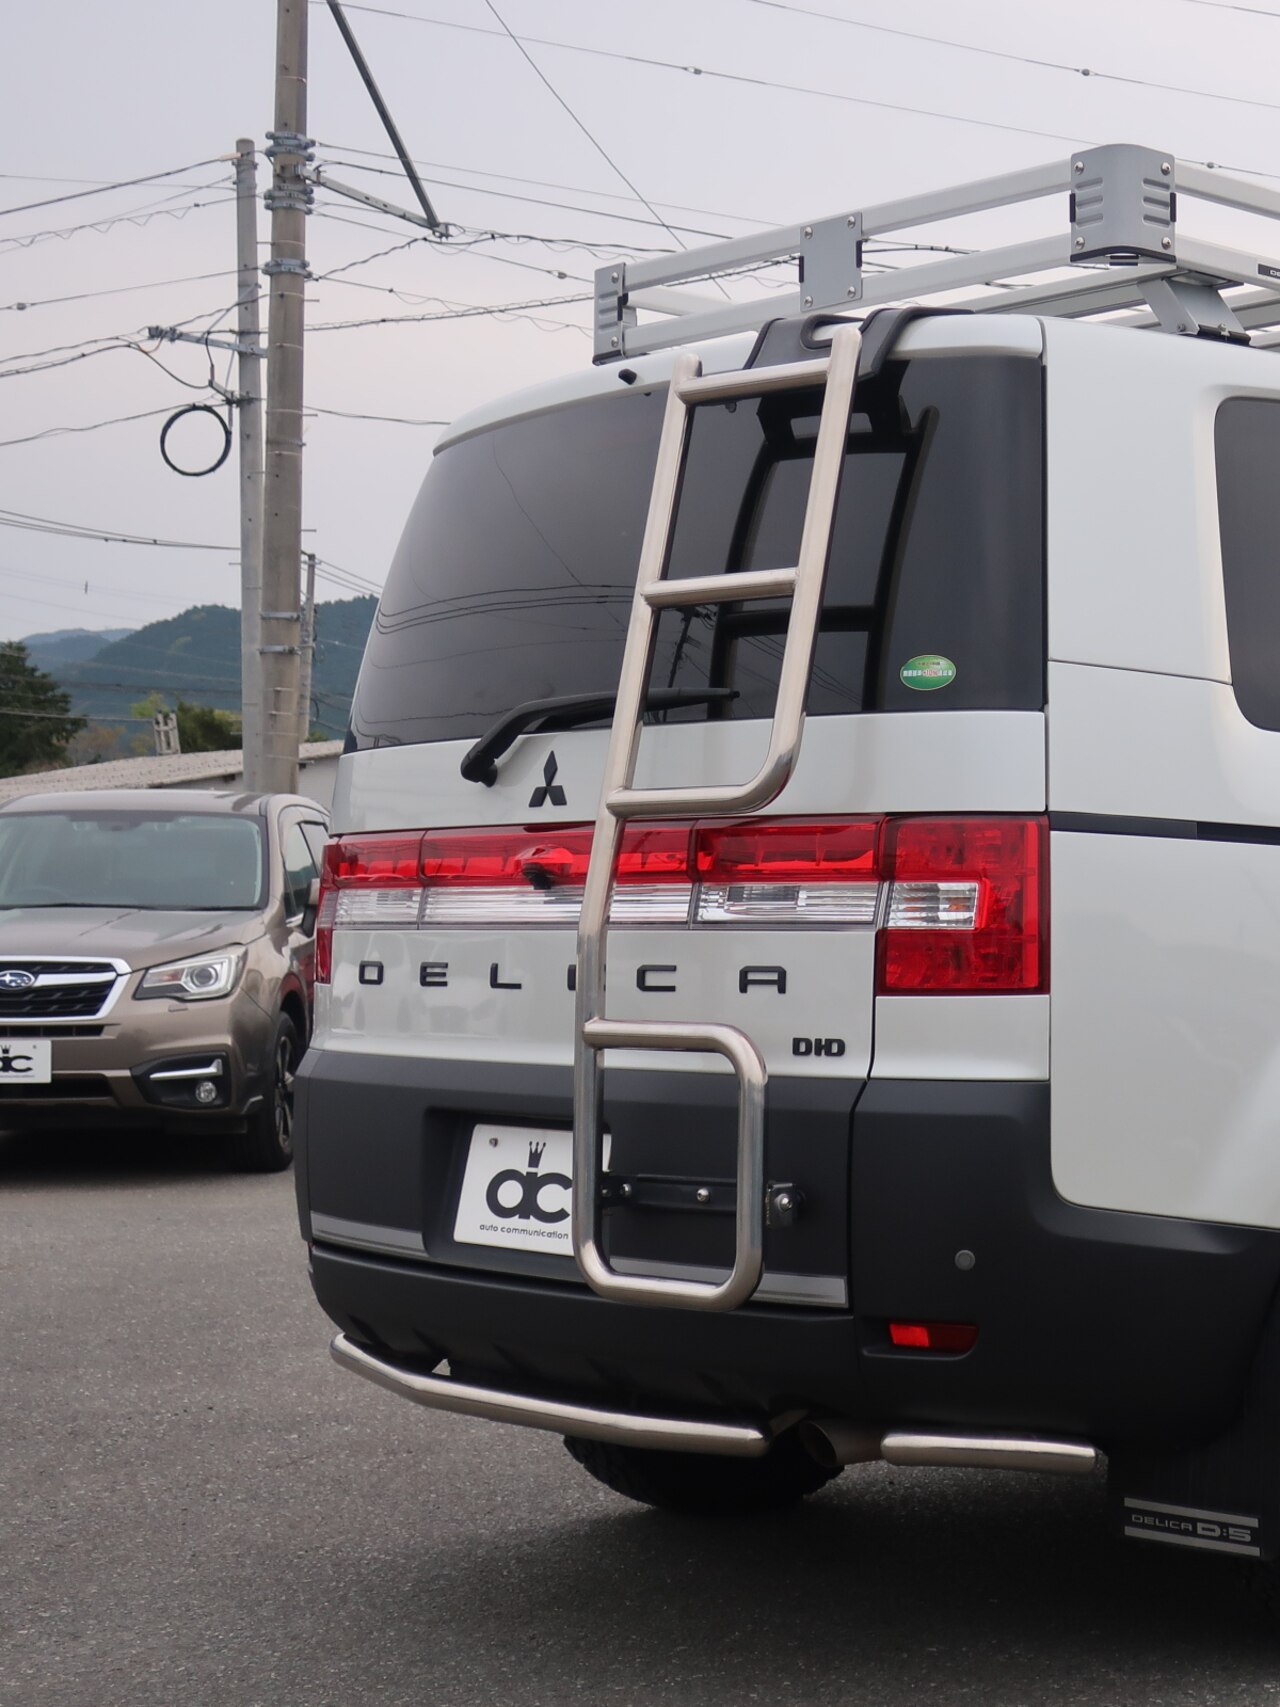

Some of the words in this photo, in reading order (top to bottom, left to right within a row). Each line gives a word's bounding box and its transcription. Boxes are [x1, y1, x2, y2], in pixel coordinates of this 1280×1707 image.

[358, 960, 787, 994] DELICA
[479, 1223, 499, 1233] auto
[500, 1226, 569, 1240] communication
[1131, 1514, 1193, 1532] DELICA
[1196, 1521, 1251, 1542] D:5
